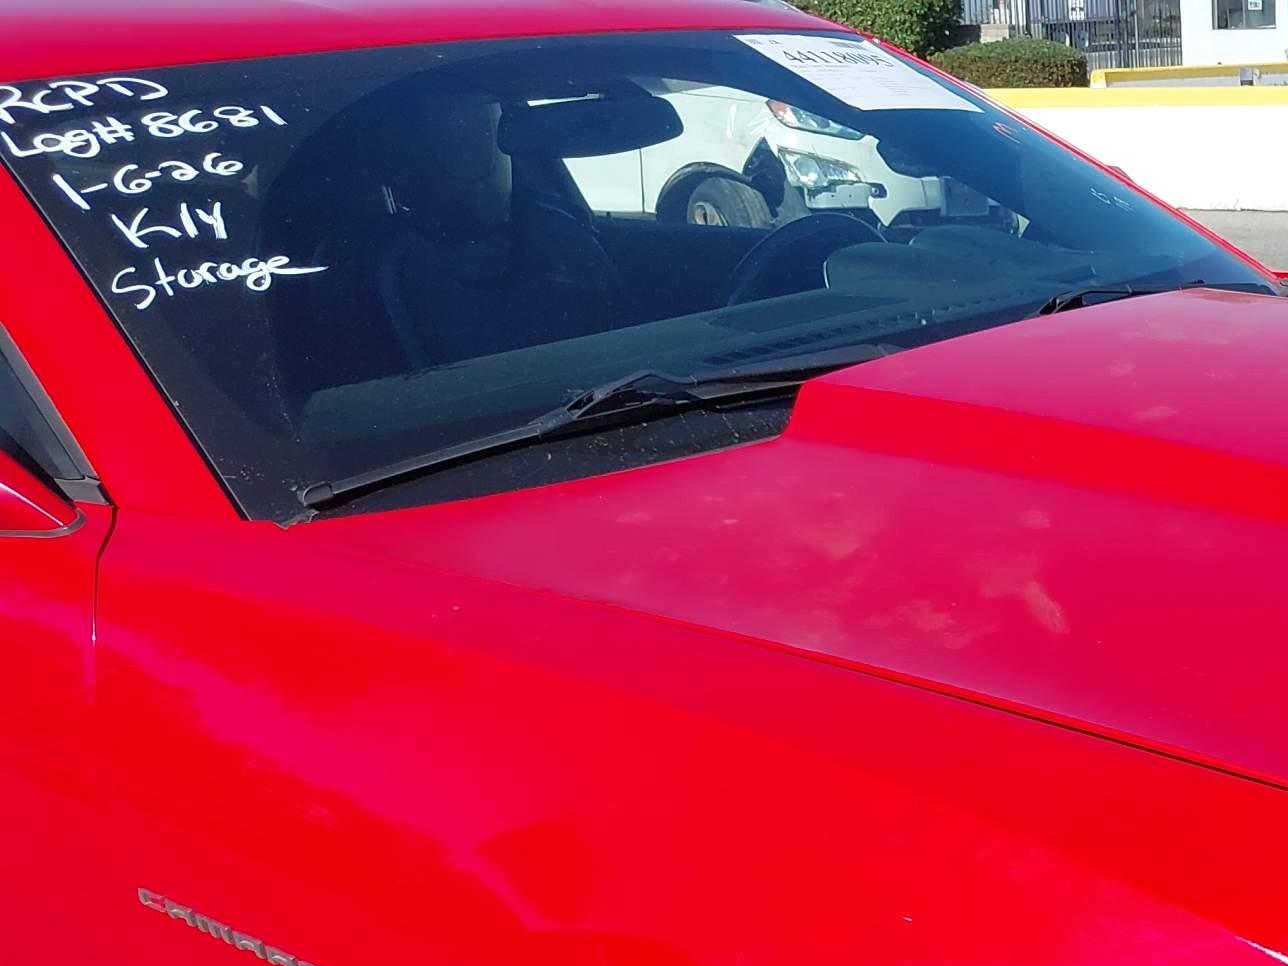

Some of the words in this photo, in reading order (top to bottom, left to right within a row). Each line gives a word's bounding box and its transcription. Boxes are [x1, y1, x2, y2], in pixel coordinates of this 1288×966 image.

[141, 105, 289, 138] 8681
[53, 152, 244, 210] 1-6-26
[111, 255, 329, 310] Storage
